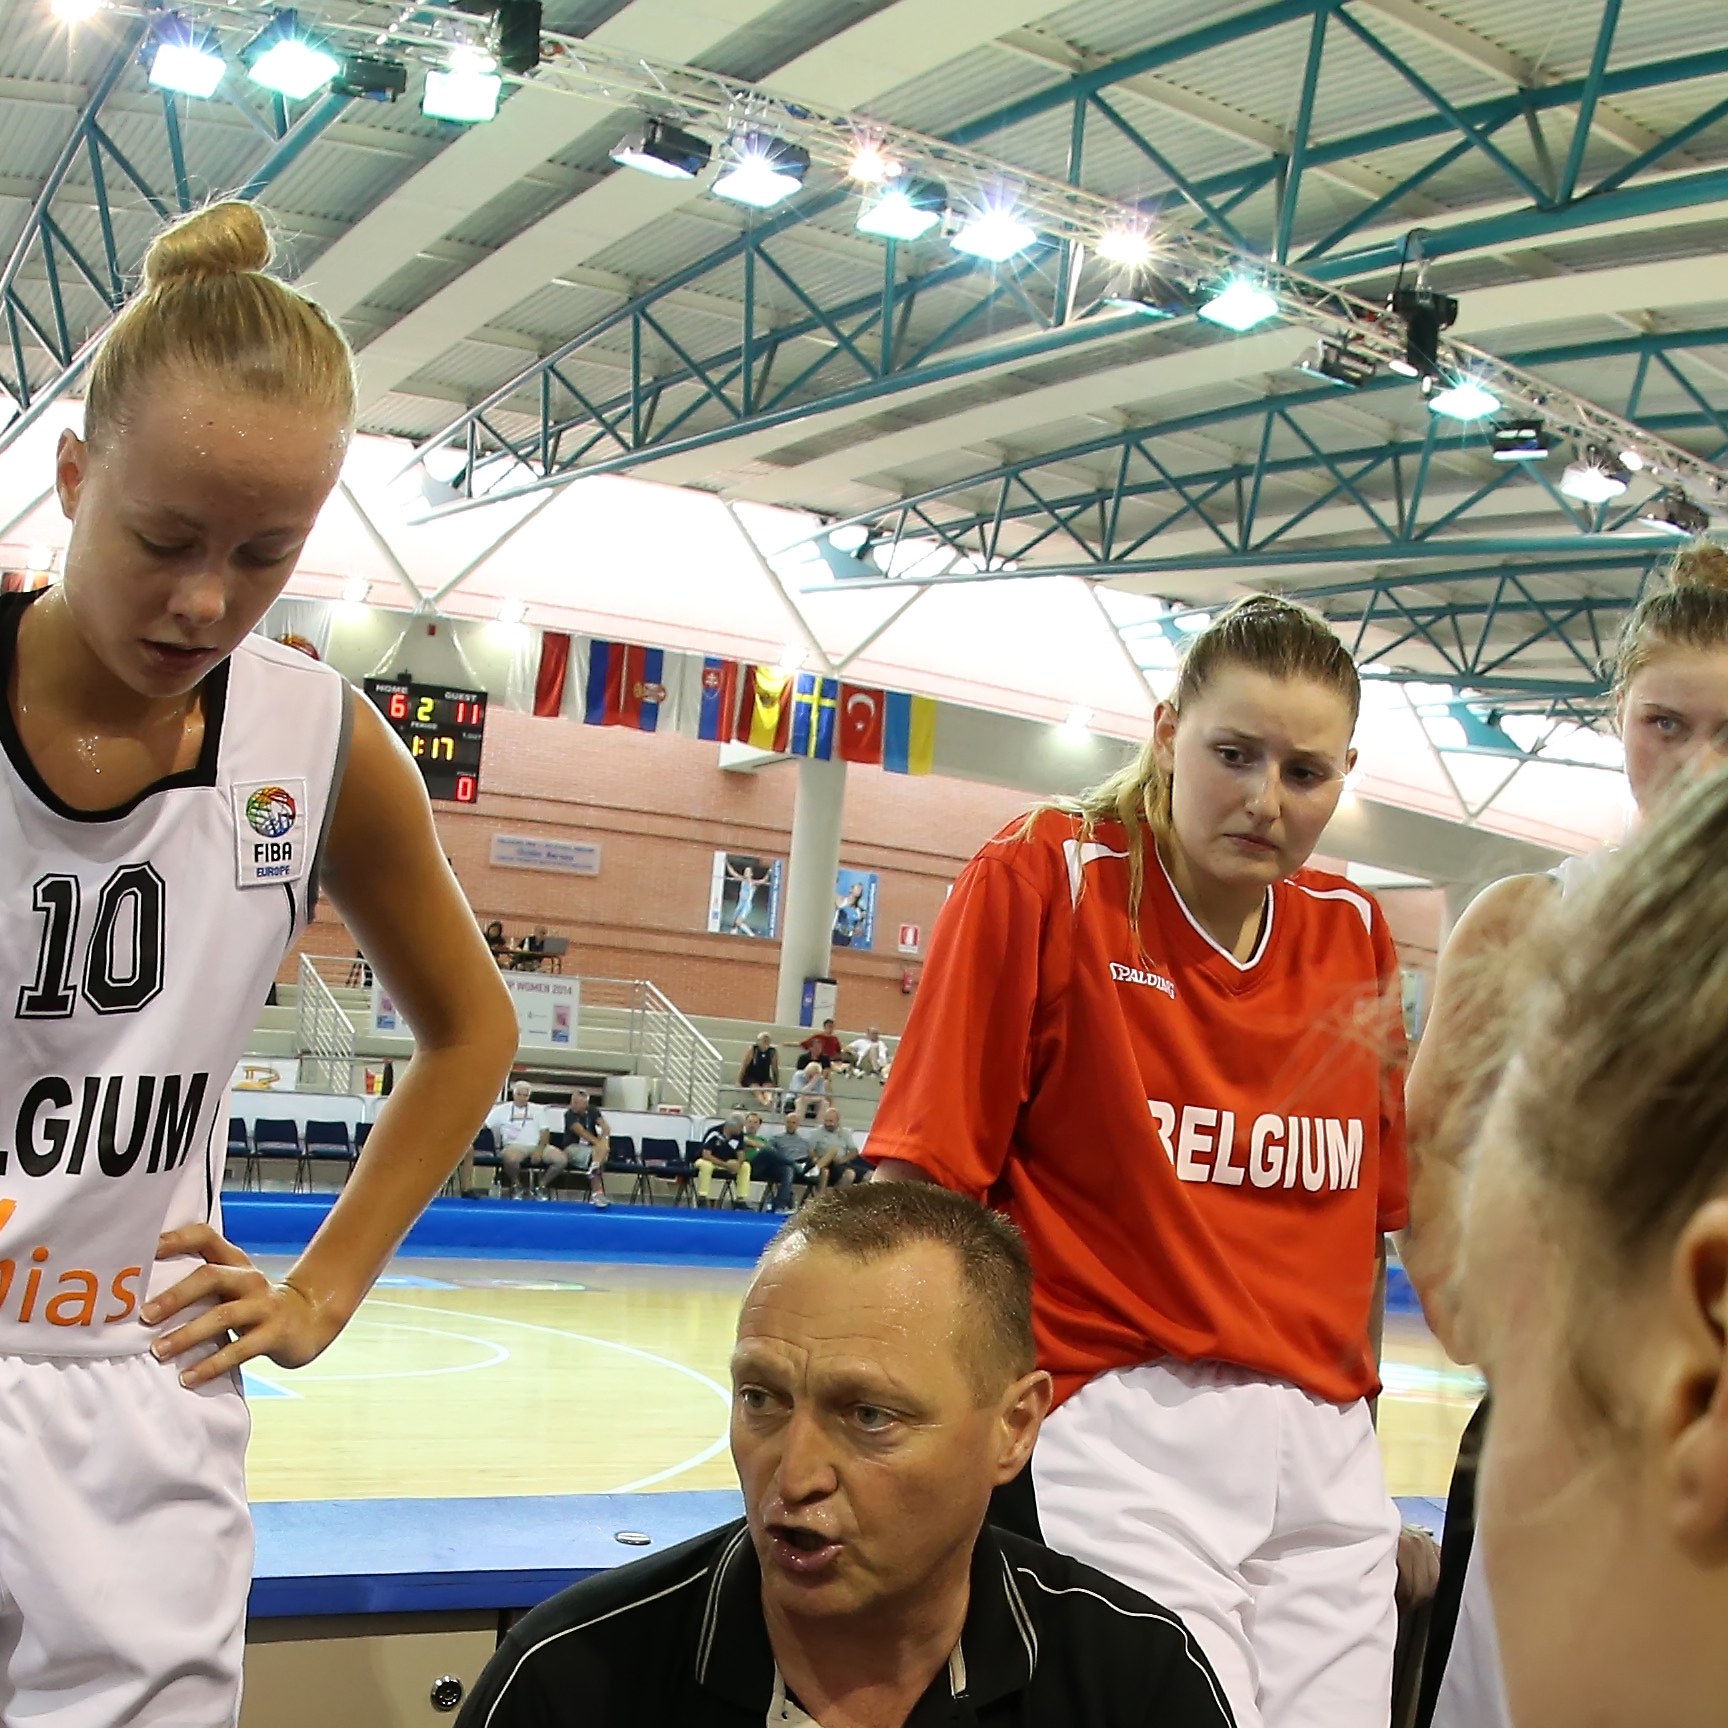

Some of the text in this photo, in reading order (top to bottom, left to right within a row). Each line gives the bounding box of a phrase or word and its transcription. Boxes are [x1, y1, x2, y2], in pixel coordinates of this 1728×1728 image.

[375, 684, 409, 694] HOME
[444, 691, 478, 702] GUEST
[390, 693, 407, 719] 6
[416, 696, 435, 722] 2
[456, 702, 481, 725] 11
[412, 735, 455, 761] 1:17
[456, 776, 475, 801] 0
[254, 842, 292, 862] FIBA
[256, 865, 291, 877] EUROPE
[14, 860, 166, 1020] 10
[1109, 962, 1175, 1000] SPALDING
